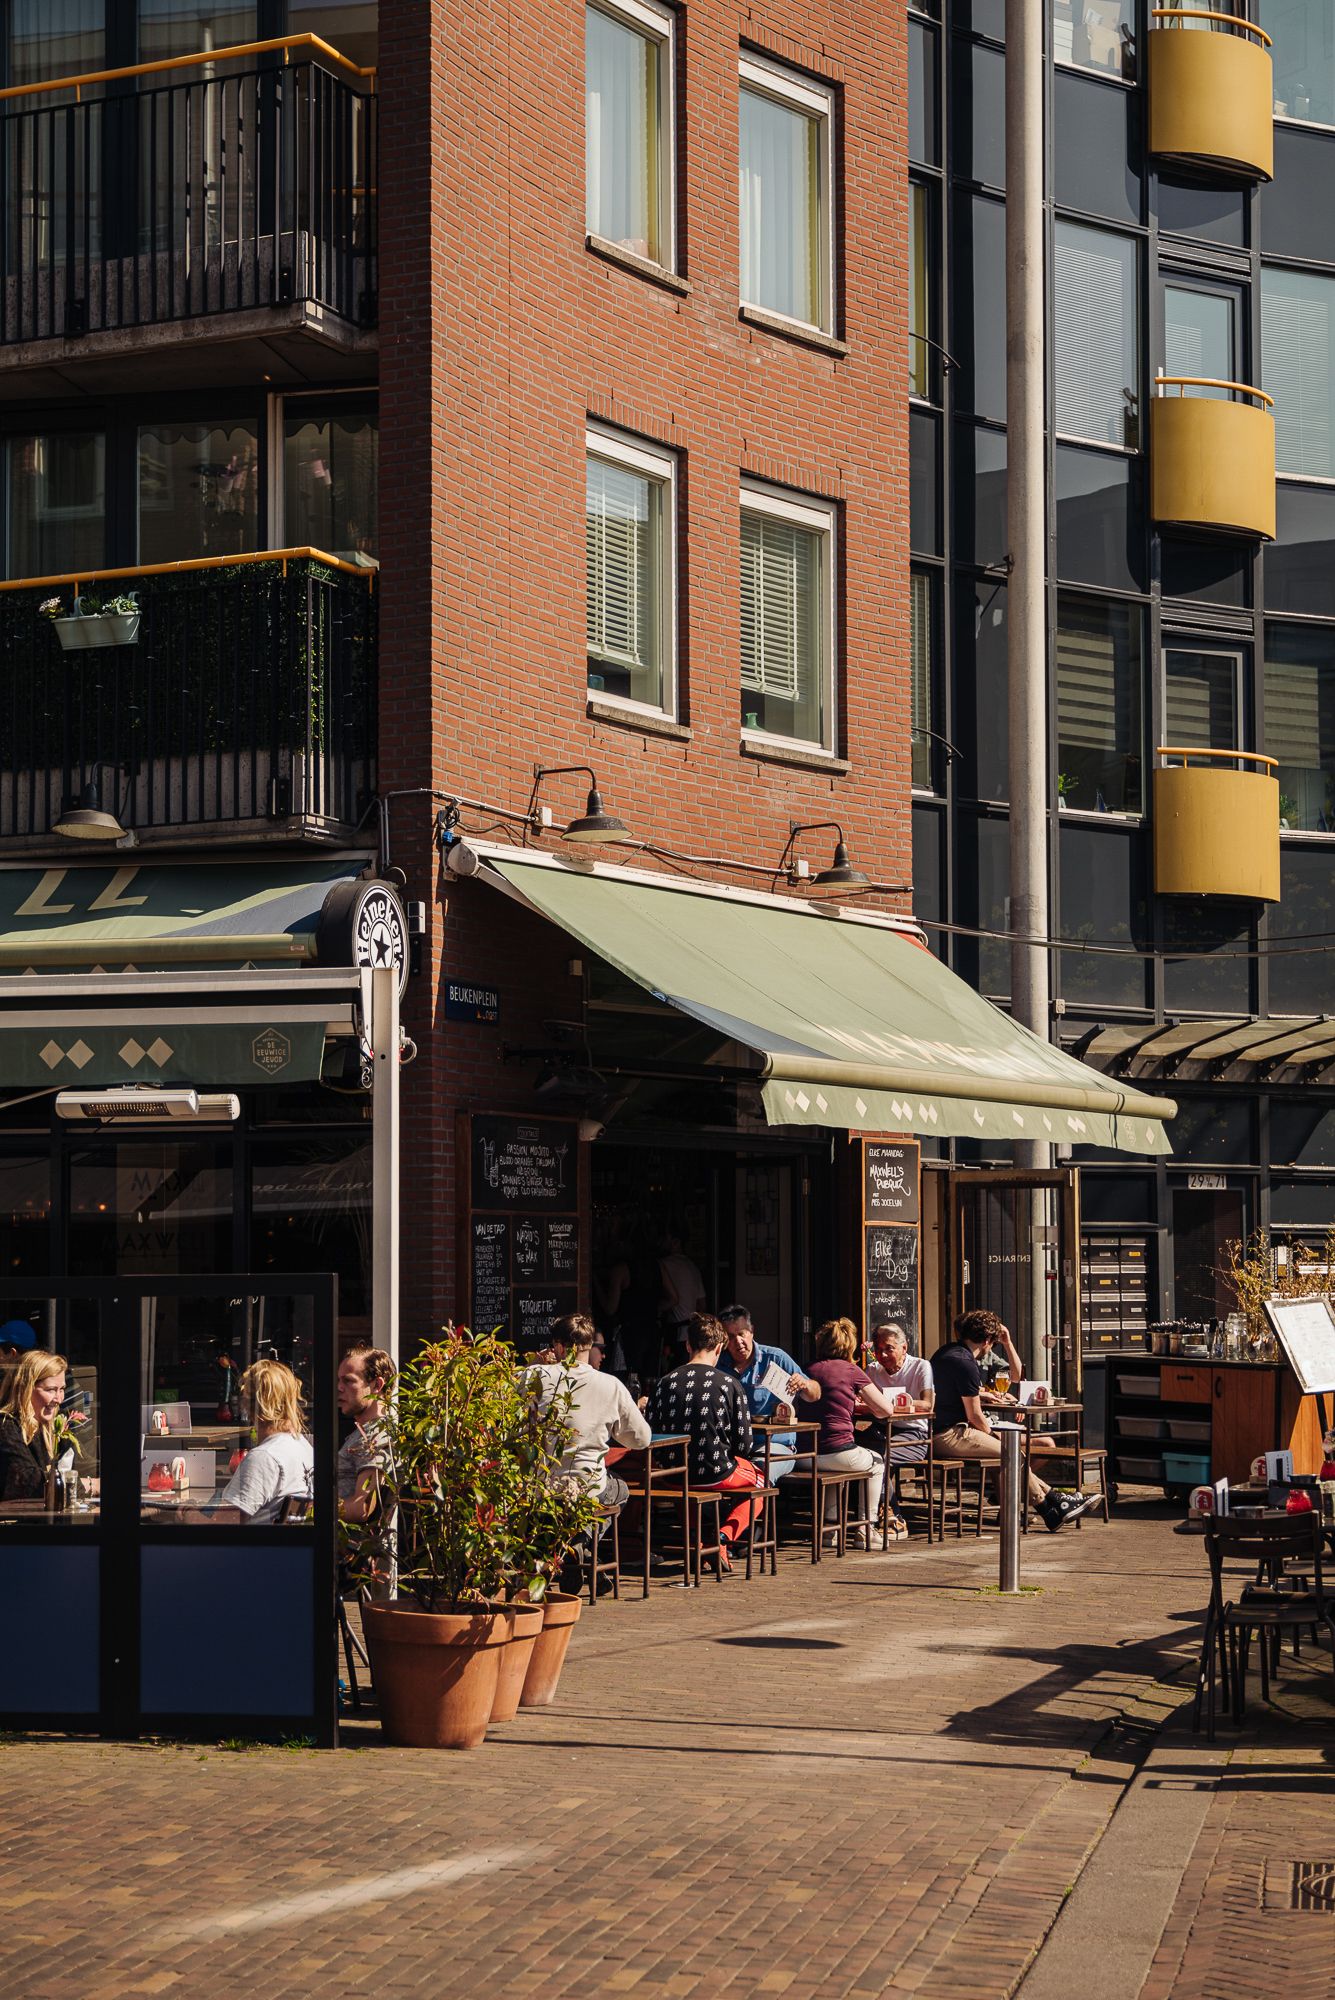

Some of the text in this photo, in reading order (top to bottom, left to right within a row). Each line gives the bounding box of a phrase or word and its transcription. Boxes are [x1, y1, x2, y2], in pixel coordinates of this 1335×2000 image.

[449, 985, 497, 1007] BEUKENPLEIN
[267, 1041, 275, 1049] DE
[256, 1048, 287, 1056] EEUWIGE
[868, 1148, 881, 1157] ELKE
[1190, 1174, 1204, 1188] 29
[1214, 1174, 1225, 1188] 71
